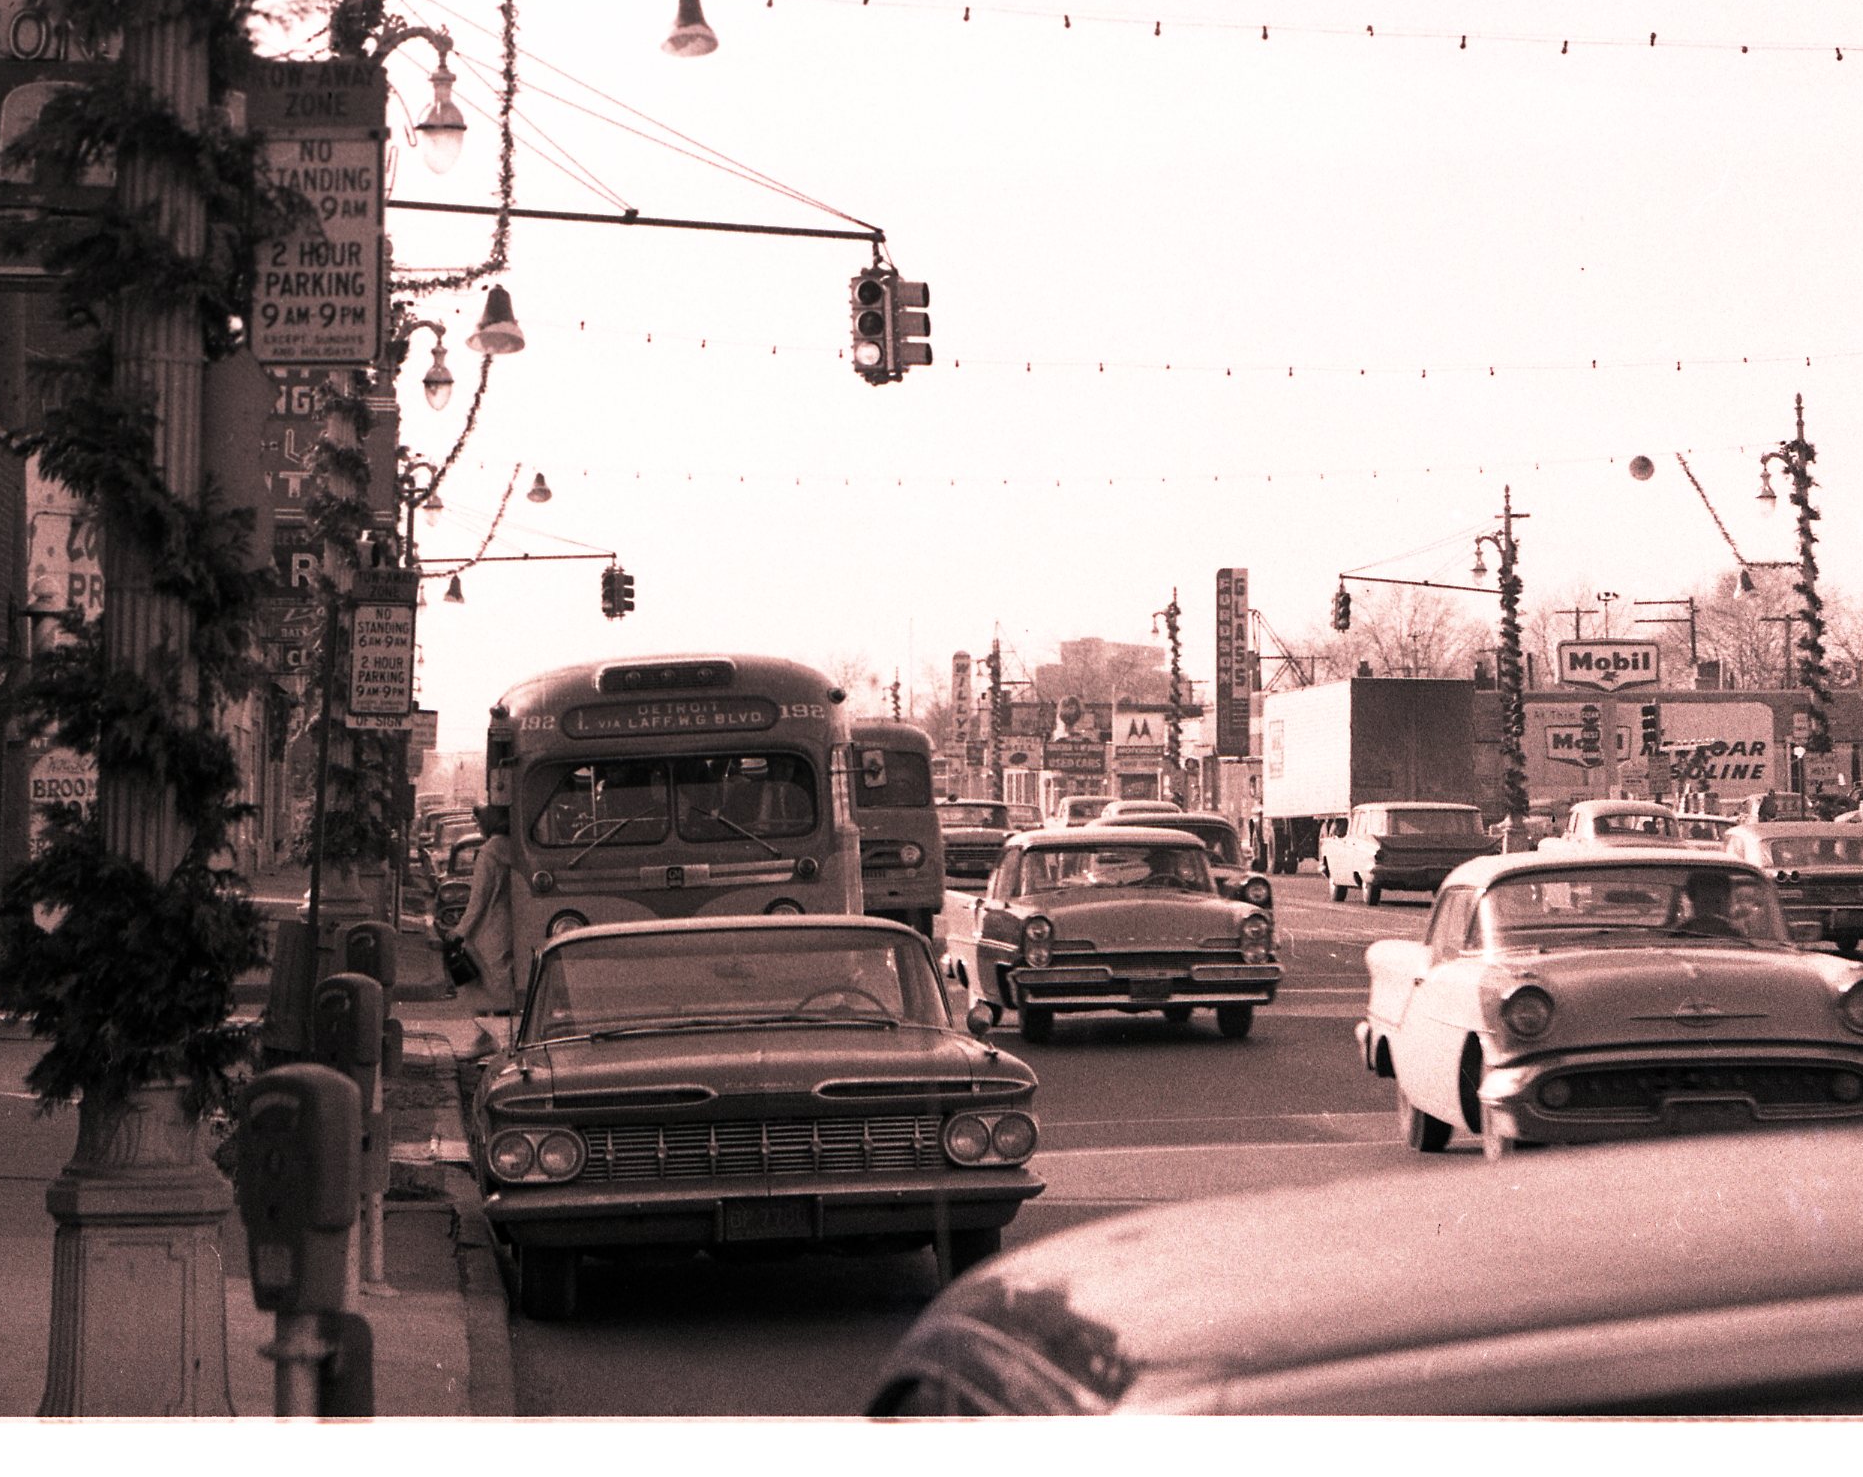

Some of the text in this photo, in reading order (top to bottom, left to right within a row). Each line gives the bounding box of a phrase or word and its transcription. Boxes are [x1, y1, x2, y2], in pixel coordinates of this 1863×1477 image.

[285, 91, 349, 118] ZONE
[298, 139, 334, 164] NO
[267, 167, 372, 193] STANDING
[271, 242, 363, 268] 2 HOUR
[265, 272, 366, 298] PARKING
[375, 607, 393, 621] NO
[357, 621, 411, 635] STANDING
[1235, 576, 1246, 687] GLASS
[360, 655, 404, 670] 2 HOUR
[1569, 651, 1650, 671] Mobil
[357, 670, 406, 685] PARKING
[637, 701, 720, 716] DETROIT
[954, 661, 971, 743] WILLYS
[375, 715, 403, 729] SIGN
[519, 714, 557, 732] 192
[598, 719, 622, 730] VIA
[779, 703, 827, 721] 192
